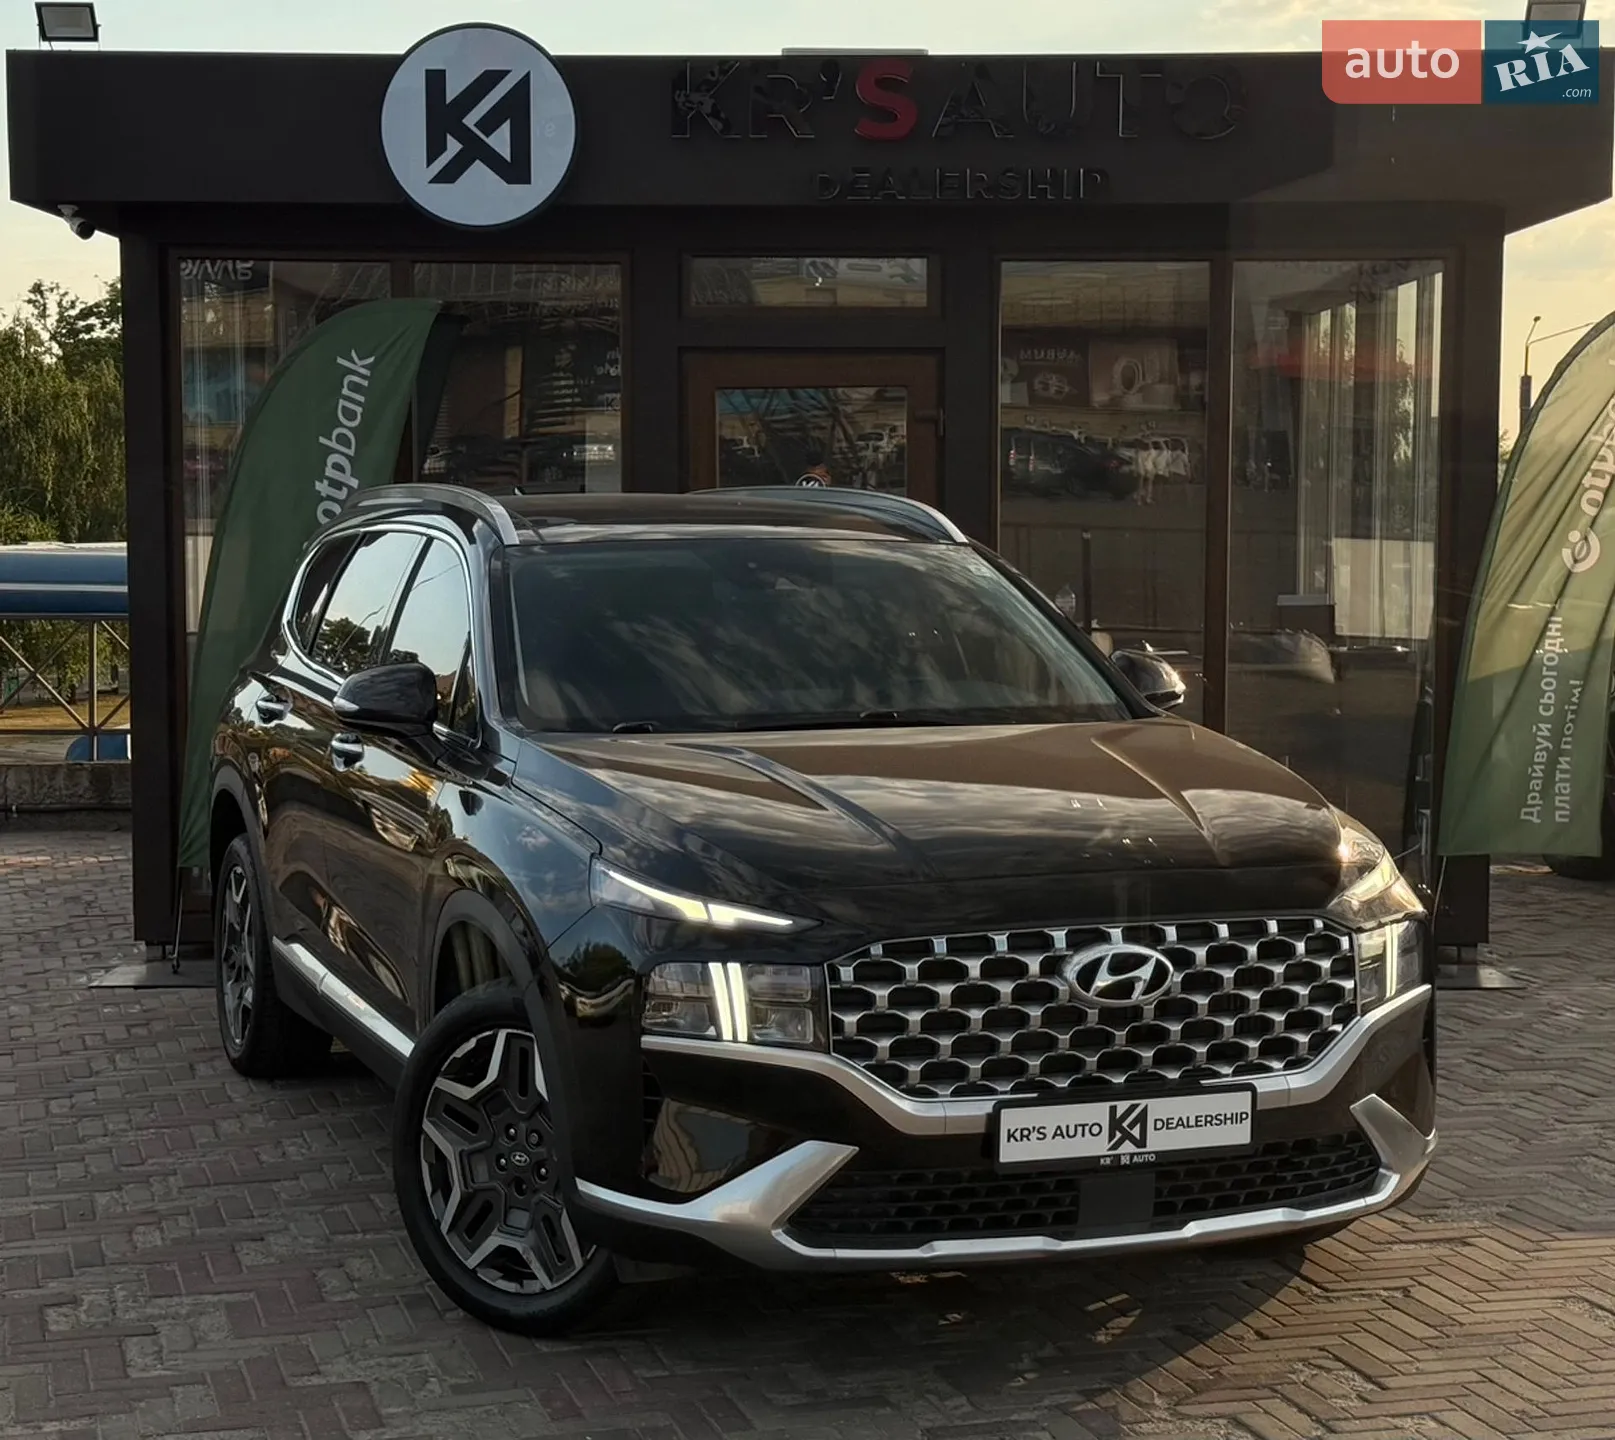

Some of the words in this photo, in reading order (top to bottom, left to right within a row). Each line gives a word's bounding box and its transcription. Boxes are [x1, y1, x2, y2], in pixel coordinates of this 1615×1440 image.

[816, 167, 1110, 200] DEALERSHIP
[315, 349, 375, 525] otpbank
[1520, 724, 1553, 823] Драйвуй
[1539, 616, 1564, 716] сьогодні
[1561, 680, 1584, 749] потім!
[1555, 756, 1571, 822] плати
[1006, 1125, 1047, 1143] KR'S
[1051, 1122, 1103, 1140] AUTO
[1153, 1111, 1249, 1132] DEALERSHIP
